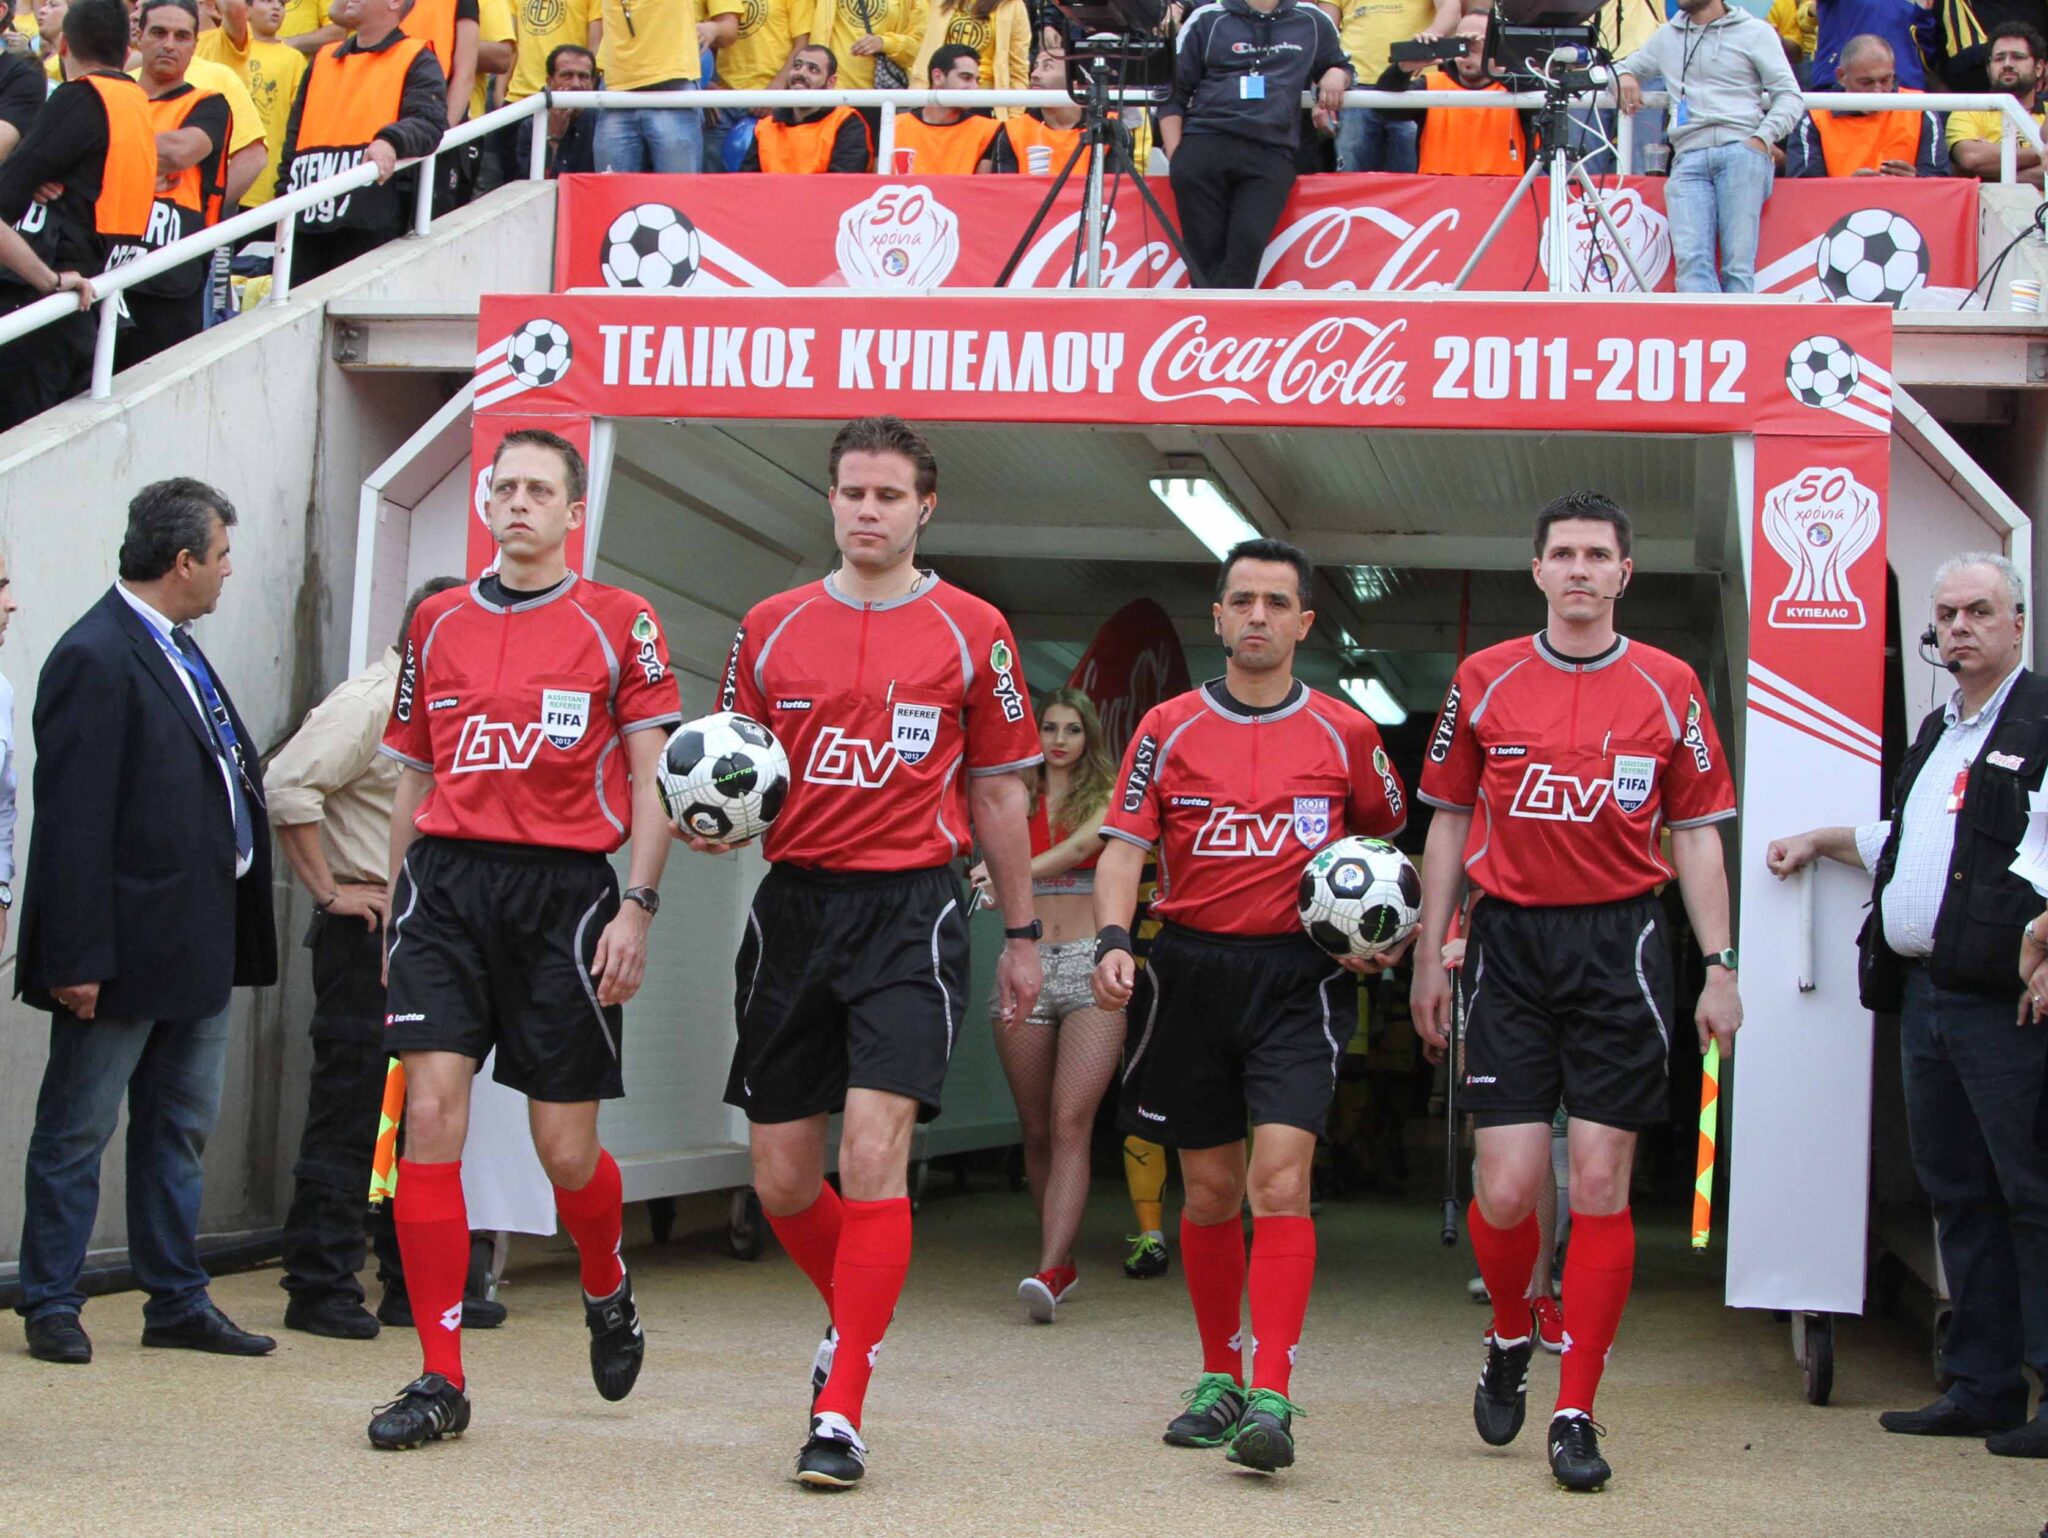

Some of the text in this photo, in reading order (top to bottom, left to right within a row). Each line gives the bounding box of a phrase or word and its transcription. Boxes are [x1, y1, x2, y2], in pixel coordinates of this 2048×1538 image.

[870, 194, 924, 225] 50
[869, 229, 923, 255] χρόνια
[599, 315, 1747, 405] ΤΕΛΙΚΟΣ ΚΥΠΕΛΛΟΥ Coca-Cola 2011-2012
[1794, 475, 1846, 503] 50
[1794, 506, 1845, 528] χρόνια
[1787, 607, 1849, 618] ΚΥΠΕΛΛΟ
[397, 639, 416, 721] CYFAST
[547, 693, 586, 703] ASSISTANT
[995, 673, 1022, 720] cyta
[549, 701, 583, 710] REFEREE
[782, 700, 812, 710] lotto
[547, 712, 581, 727] FIFA
[897, 708, 937, 719] REFEREE
[1430, 684, 1461, 762] CYFAST
[898, 726, 930, 741] FIFA
[555, 737, 571, 745] 2012
[1686, 724, 1709, 770] cyta
[904, 752, 920, 760] 2012
[1497, 746, 1526, 756] lotto
[718, 766, 754, 782] LOTTO
[1124, 735, 1157, 811] CYFAST
[1618, 777, 1647, 791] FIFA
[1179, 797, 1210, 807] lotto
[1297, 799, 1326, 809] ΚΟΠ
[1623, 801, 1637, 809] 2012
[394, 1013, 426, 1023] lotto
